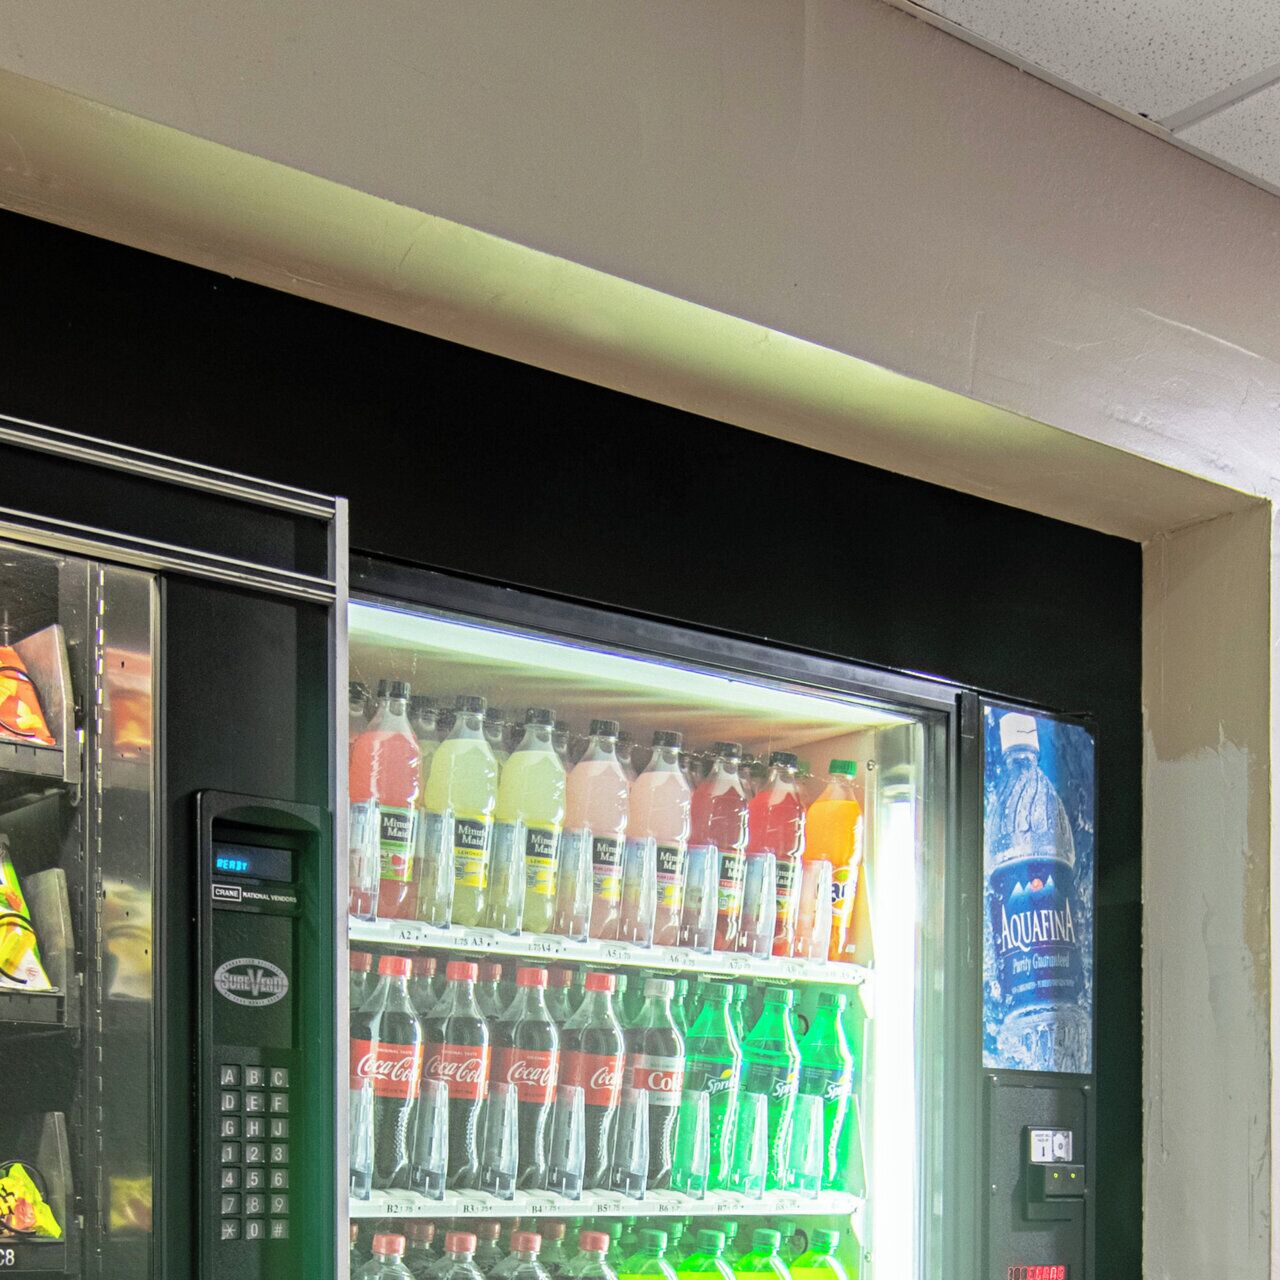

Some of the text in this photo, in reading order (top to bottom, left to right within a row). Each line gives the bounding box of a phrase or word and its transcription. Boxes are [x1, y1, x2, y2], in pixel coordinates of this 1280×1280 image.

[215, 888, 239, 898] CRANE
[242, 891, 270, 901] NATIONAL
[1000, 897, 1076, 953] AQUAFINA
[399, 930, 412, 941] A2
[471, 936, 484, 947] A3
[540, 943, 552, 953] A4
[225, 1070, 283, 1085] A B C
[250, 1148, 259, 1161] 2
[274, 1148, 283, 1161] 3
[387, 1203, 399, 1214] B2
[463, 1204, 475, 1214] B3
